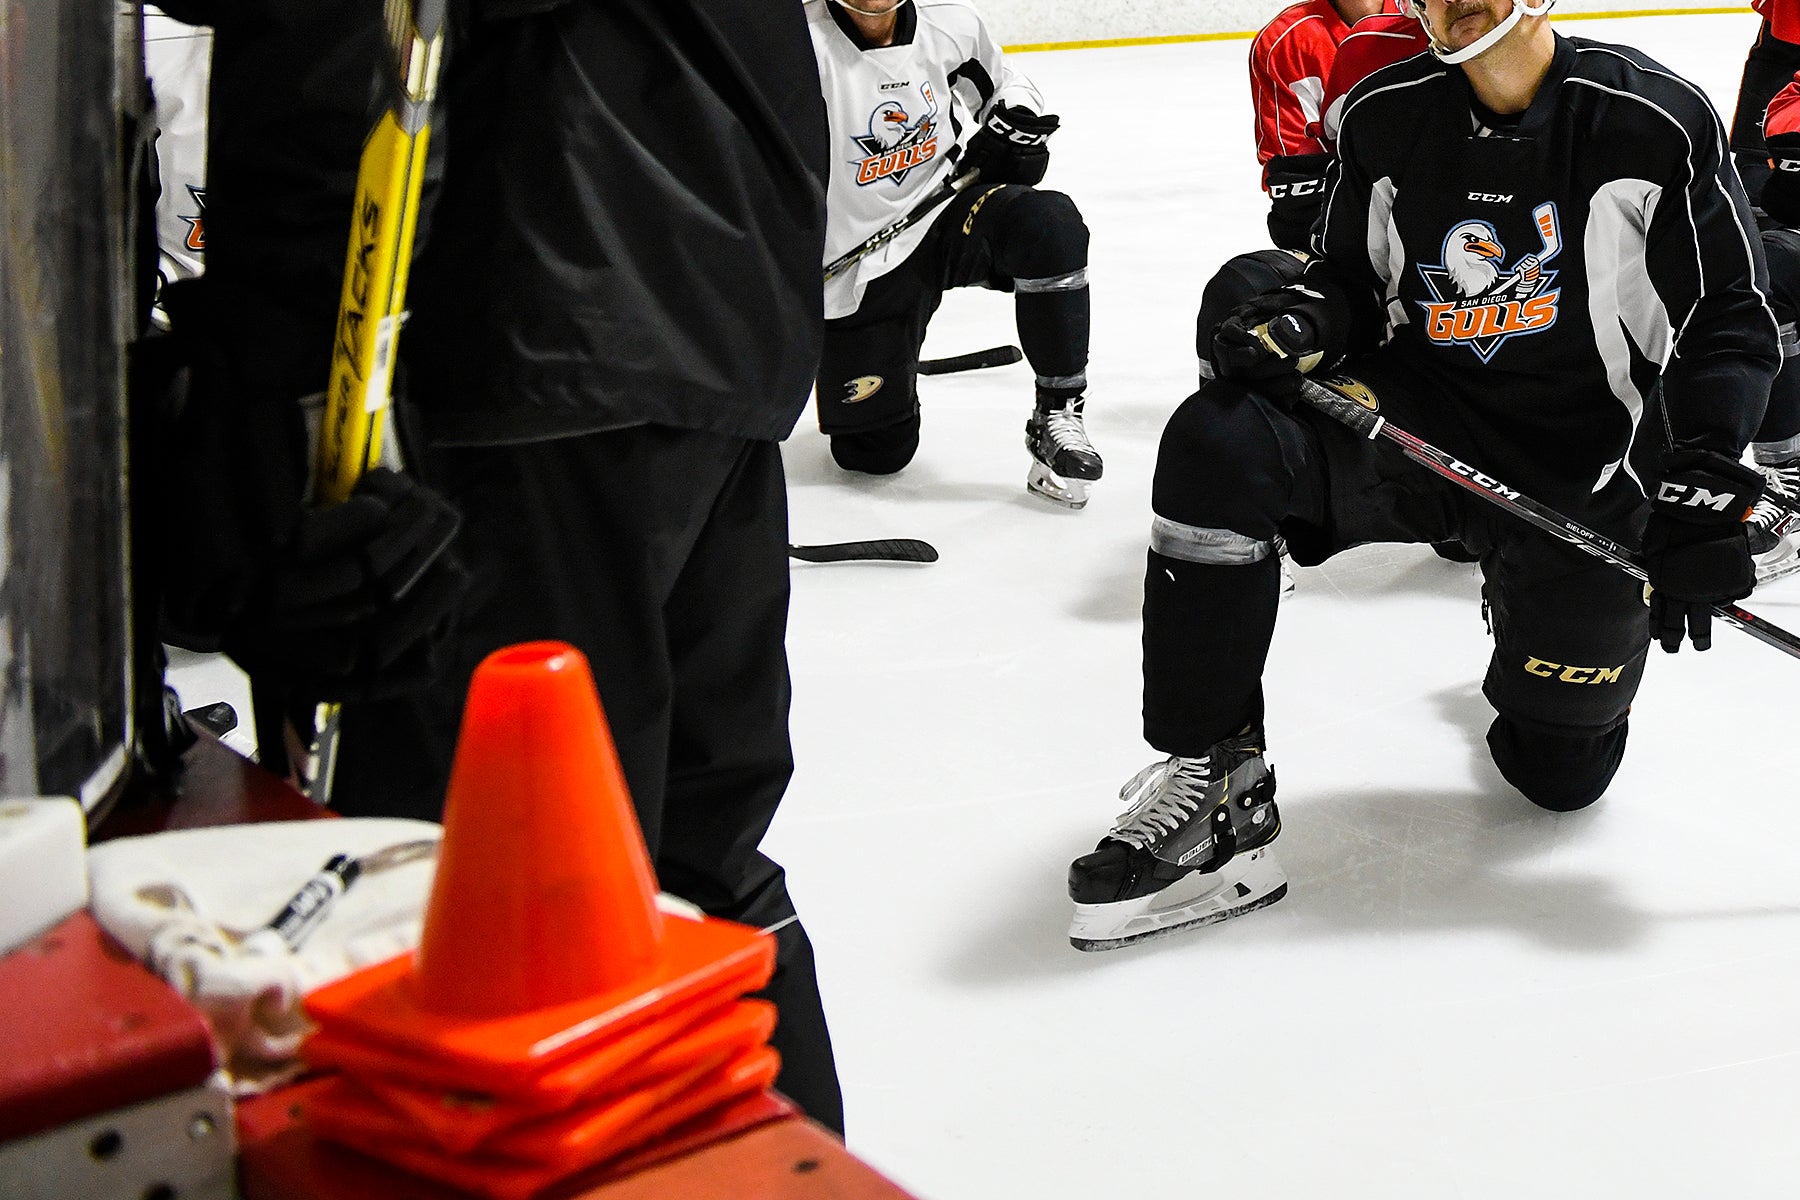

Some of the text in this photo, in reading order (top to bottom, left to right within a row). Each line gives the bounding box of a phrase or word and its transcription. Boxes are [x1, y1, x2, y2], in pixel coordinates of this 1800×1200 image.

[880, 81, 910, 90] CCM
[852, 136, 938, 185] GULLS
[1467, 191, 1514, 203] CCM
[1461, 294, 1508, 308] SAN DIEGO
[1420, 292, 1557, 341] GULLS
[1450, 459, 1521, 501] CCM
[1565, 521, 1595, 540] SIELOFF
[1524, 655, 1626, 685] CCM
